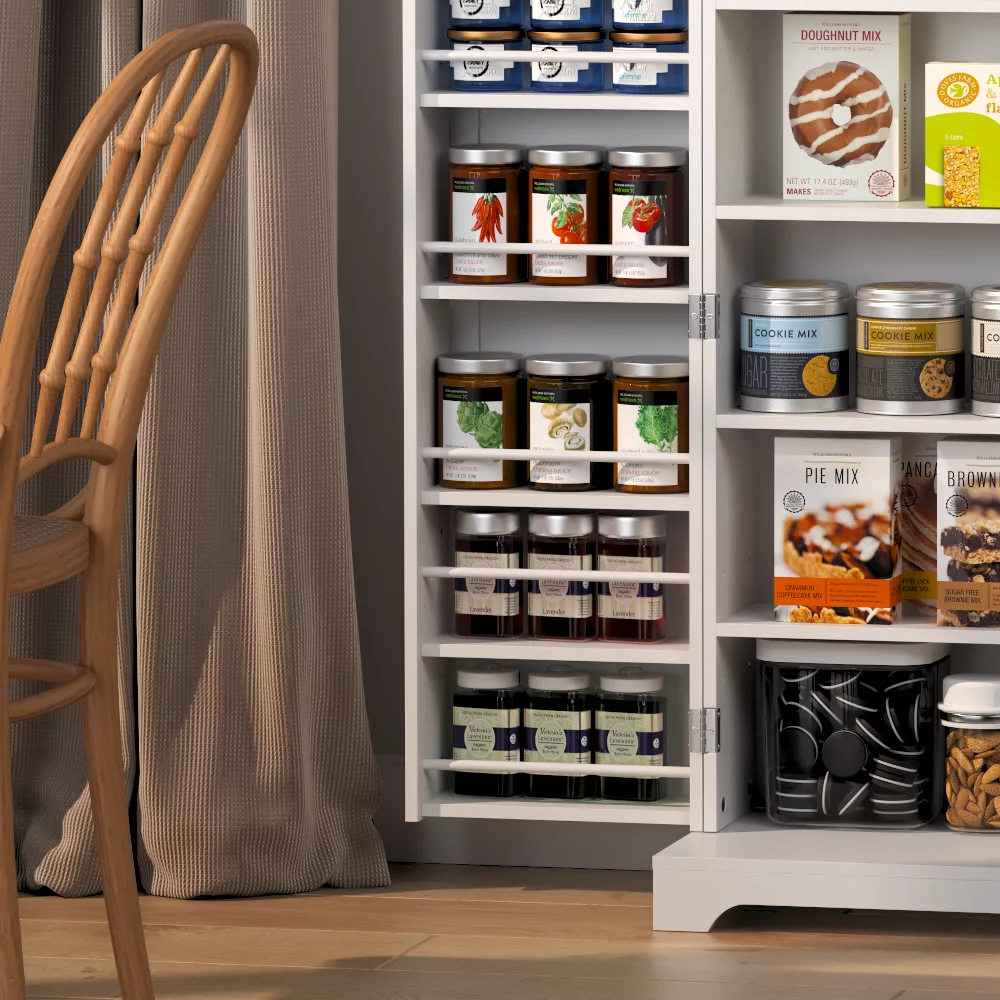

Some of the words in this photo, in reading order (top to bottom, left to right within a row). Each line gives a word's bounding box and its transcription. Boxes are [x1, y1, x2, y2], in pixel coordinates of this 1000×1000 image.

[801, 29, 858, 41] DOUGHNUT
[862, 30, 882, 42] MIX
[939, 74, 957, 96] DOVES
[958, 74, 976, 88] FARM
[943, 91, 977, 107] ORGANIC
[986, 89, 997, 99] &
[755, 329, 794, 338] COOKIE
[797, 329, 818, 338] MIX
[871, 332, 910, 341] COOKIE
[805, 467, 826, 484] PIE
[835, 468, 859, 484] MIX
